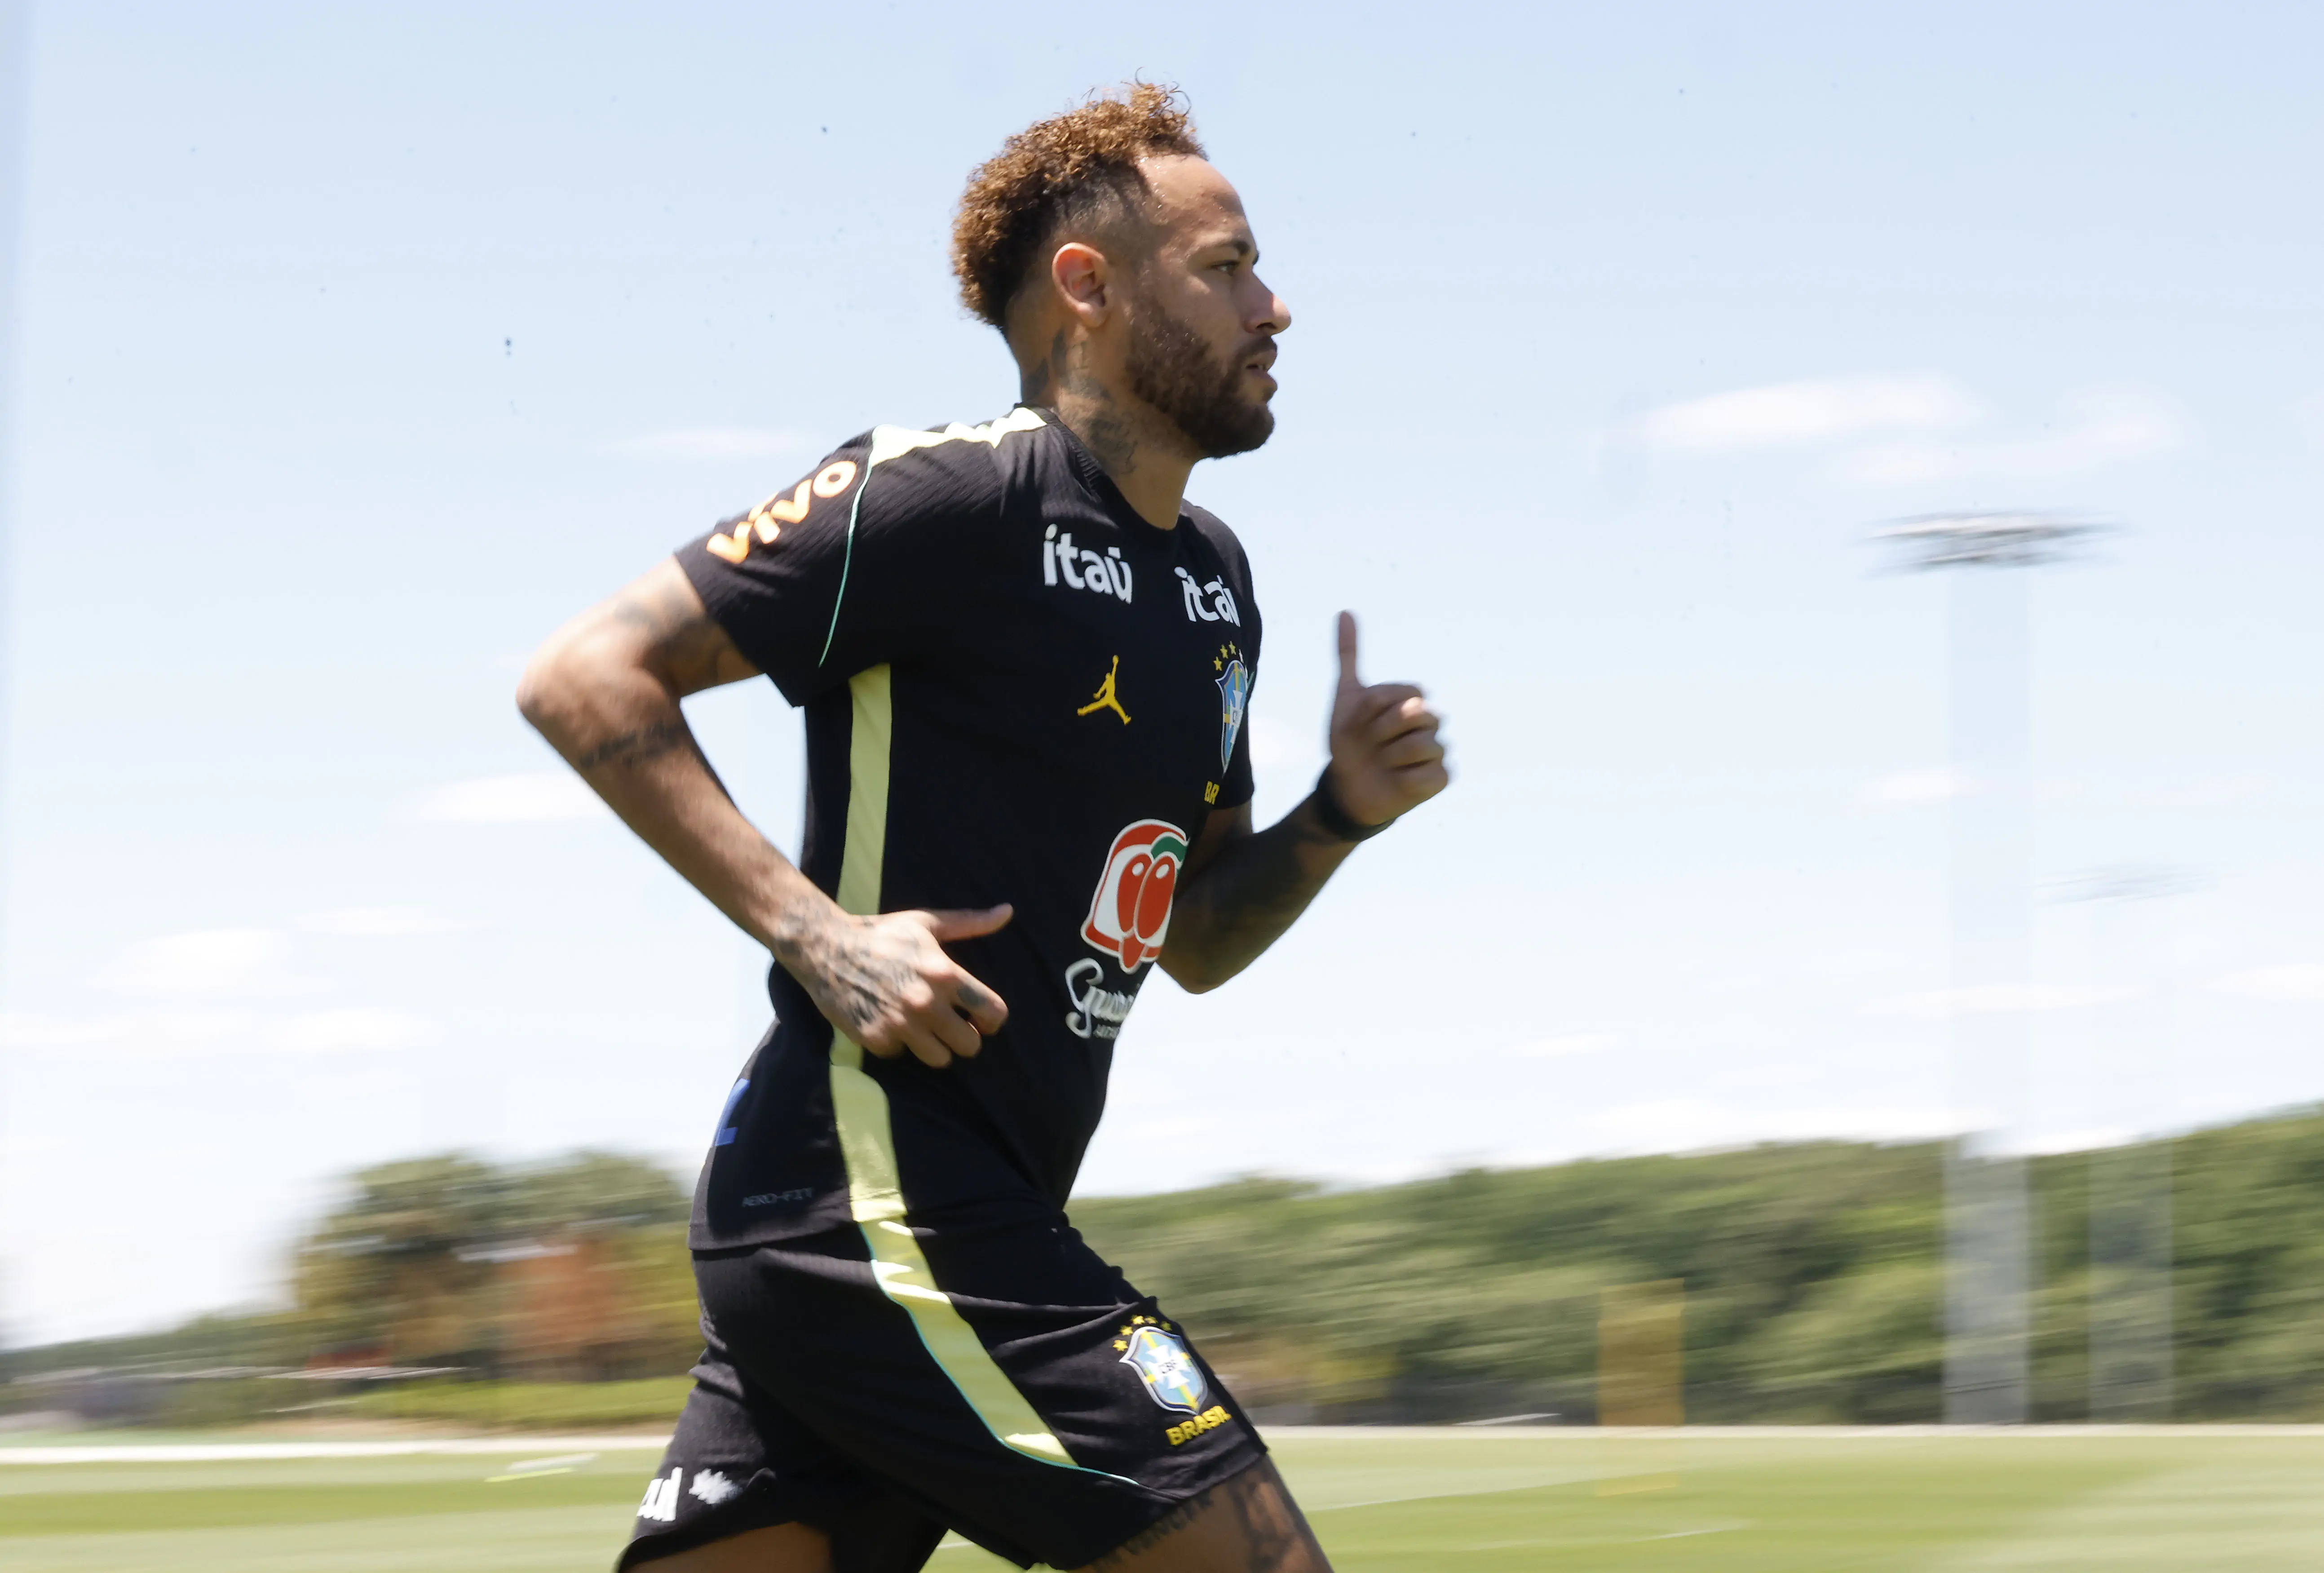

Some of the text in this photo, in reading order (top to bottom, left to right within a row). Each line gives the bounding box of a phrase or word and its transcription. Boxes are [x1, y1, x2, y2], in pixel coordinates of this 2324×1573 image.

[706, 461, 857, 564] vivo
[1043, 523, 1133, 603] itaú
[1204, 780, 1220, 805] BR
